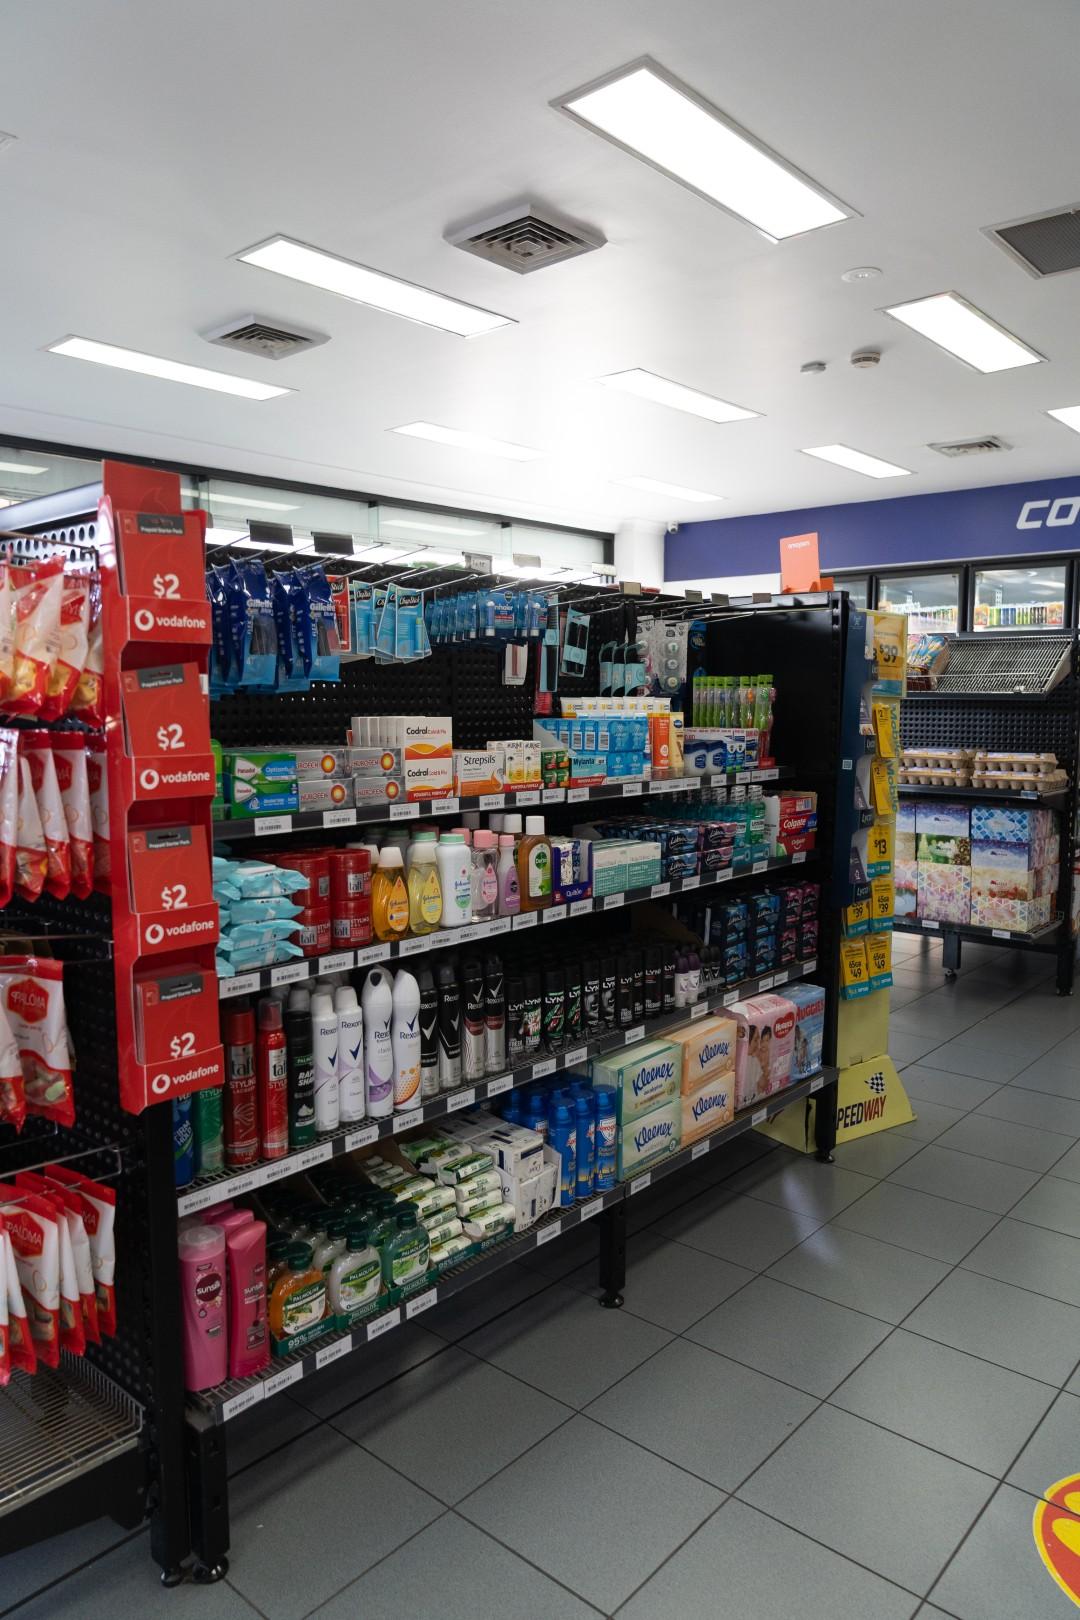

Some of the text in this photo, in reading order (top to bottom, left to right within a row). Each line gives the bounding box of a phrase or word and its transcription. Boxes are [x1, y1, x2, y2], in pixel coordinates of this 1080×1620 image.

[153, 573, 181, 599] $2
[156, 614, 207, 628] vodafone
[156, 723, 185, 751] $2
[406, 726, 428, 735] Codral
[464, 754, 496, 766] Strepsils
[573, 758, 595, 766] Mylanta
[162, 770, 210, 783] vodafone
[408, 768, 428, 778] Codral
[784, 818, 806, 830] Colgate
[874, 840, 887, 854] $13
[161, 884, 188, 910] $2
[166, 920, 214, 936] vodafone
[11, 990, 46, 1009] PALOMA
[508, 1003, 524, 1011] LYN
[342, 1020, 362, 1028] Rexon
[374, 1031, 390, 1040] Rexo
[170, 1032, 196, 1060] $2
[699, 1042, 730, 1068] Kleenex
[172, 1064, 219, 1085] vodafone
[298, 1070, 314, 1080] RAP
[632, 1062, 675, 1096] Kleenex
[298, 1078, 314, 1086] SHA
[692, 1093, 727, 1122] Kleenex
[836, 1095, 887, 1130] PEEDWAY
[634, 1122, 673, 1152] Kleenex
[5, 1222, 44, 1247] PALOMA
[402, 1242, 426, 1257] PALMOLIVE
[350, 1266, 375, 1280] PALMOLIVE
[293, 1286, 320, 1302] PALMOLIVE
[288, 1334, 306, 1348] 95%
